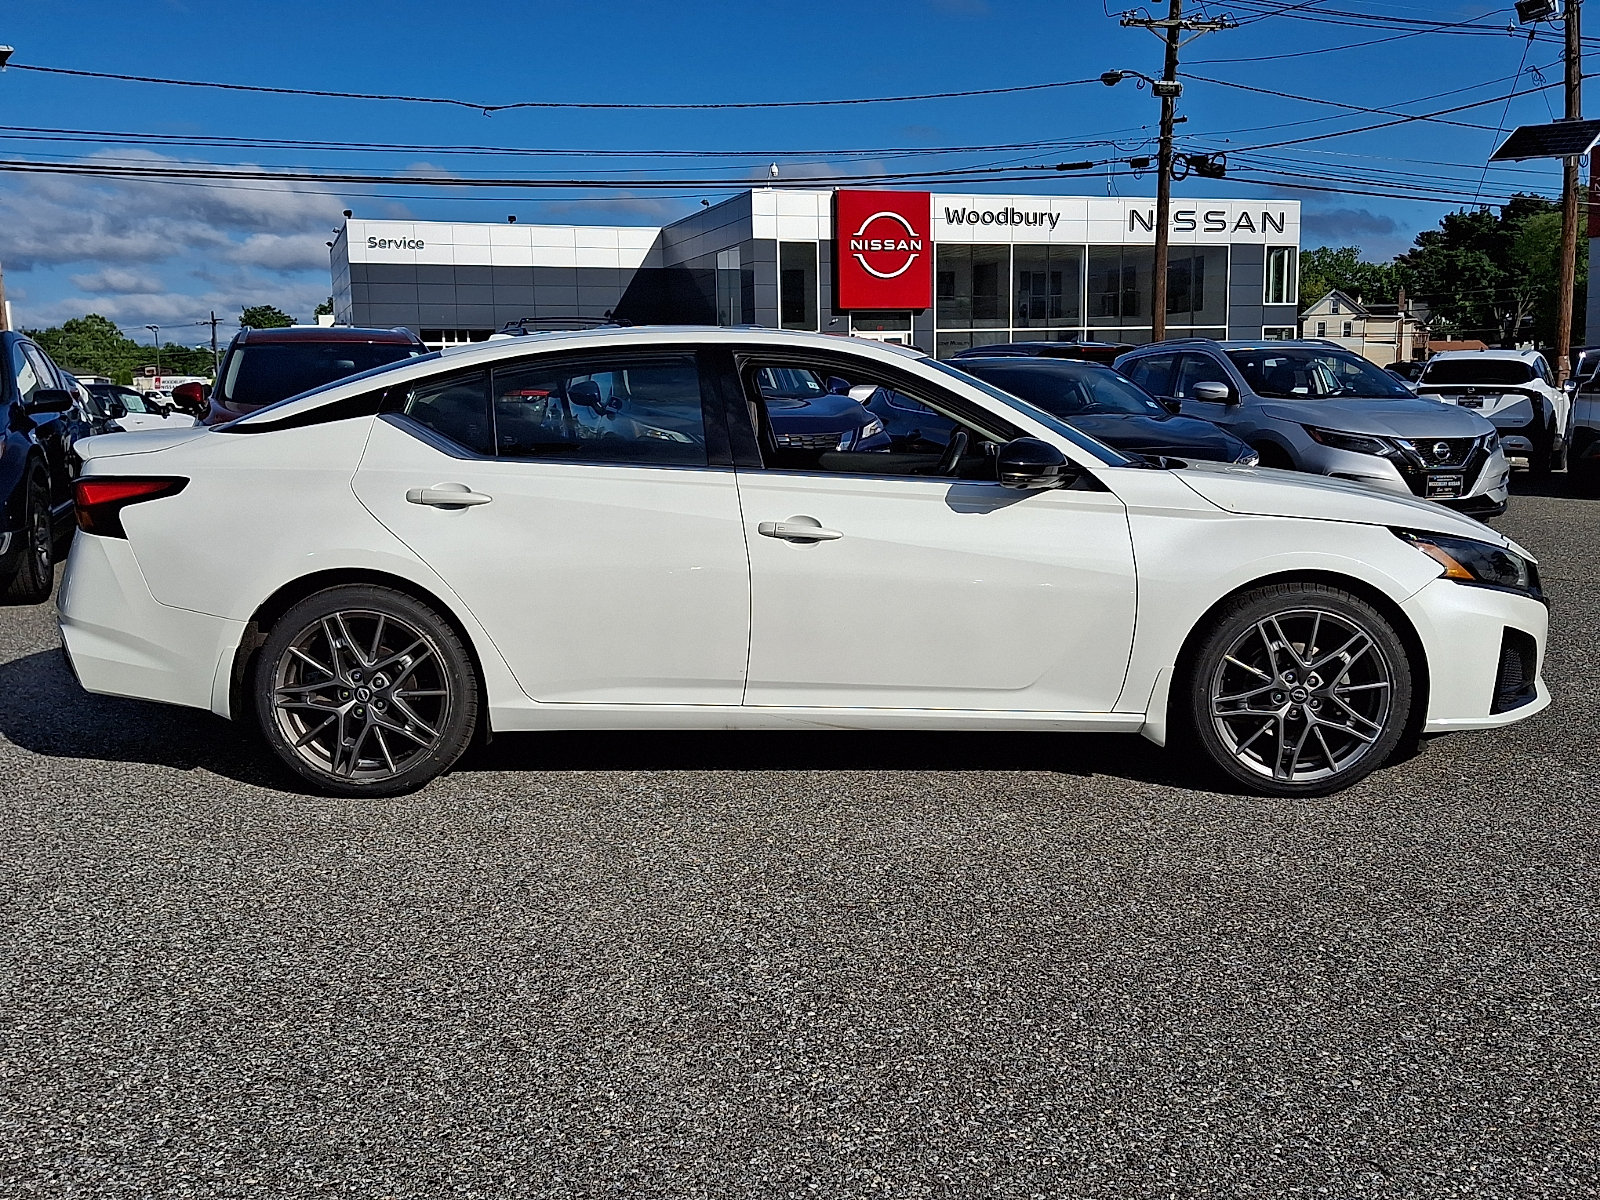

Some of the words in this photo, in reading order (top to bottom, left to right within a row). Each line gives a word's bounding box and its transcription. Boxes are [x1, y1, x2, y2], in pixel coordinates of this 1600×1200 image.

[944, 206, 1061, 231] Woodbury
[1129, 209, 1285, 233] NSSAN
[367, 236, 424, 249] Service
[850, 239, 922, 251] NISSAN
